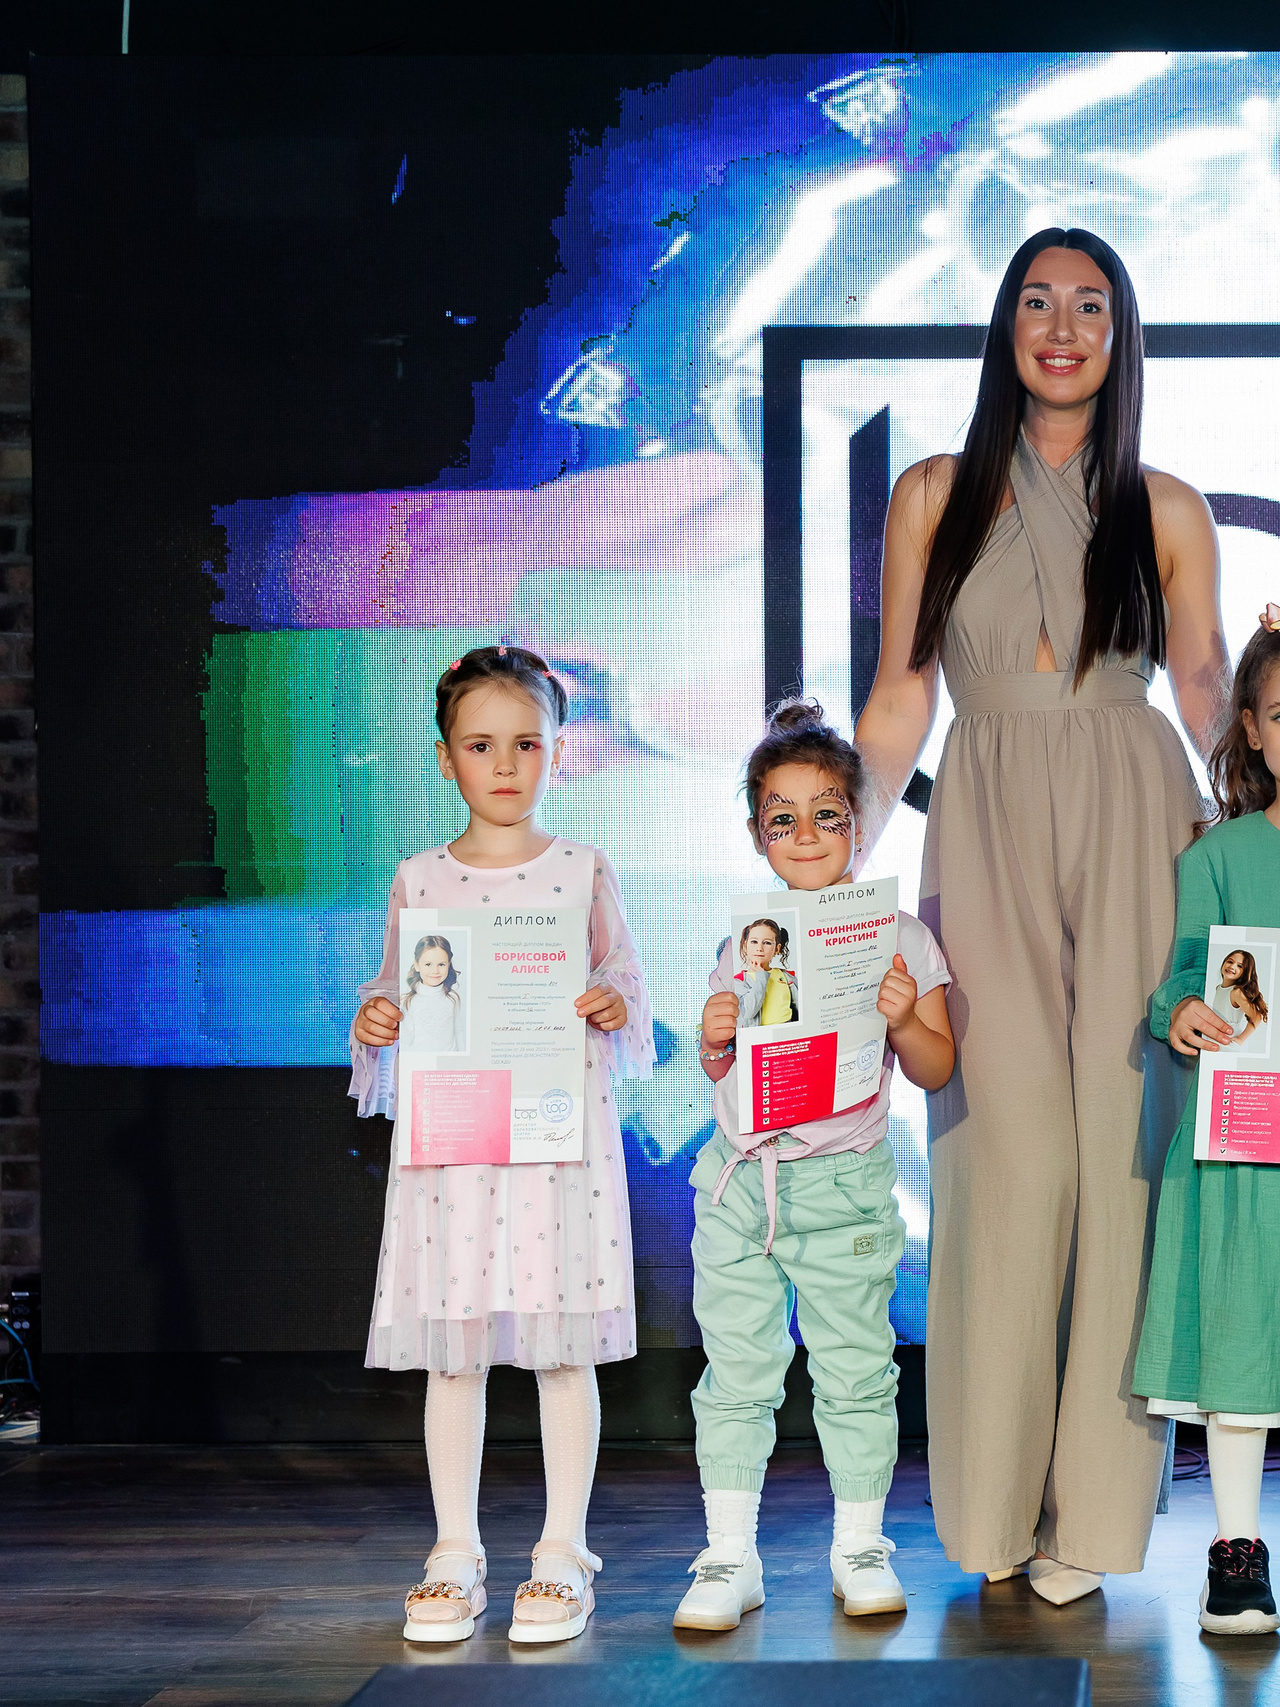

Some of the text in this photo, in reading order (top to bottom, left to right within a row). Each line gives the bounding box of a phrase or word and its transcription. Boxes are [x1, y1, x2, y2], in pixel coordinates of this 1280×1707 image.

[818, 888, 876, 905] ДИПЛОМ
[493, 915, 556, 927] ДИПЛОМ
[808, 914, 895, 938] ОВЧИННИКОВОЙ
[825, 930, 878, 947] КРИСТИНЕ
[495, 950, 566, 962] БОРИСОВОЙ
[511, 965, 549, 974] АЛИСЕ
